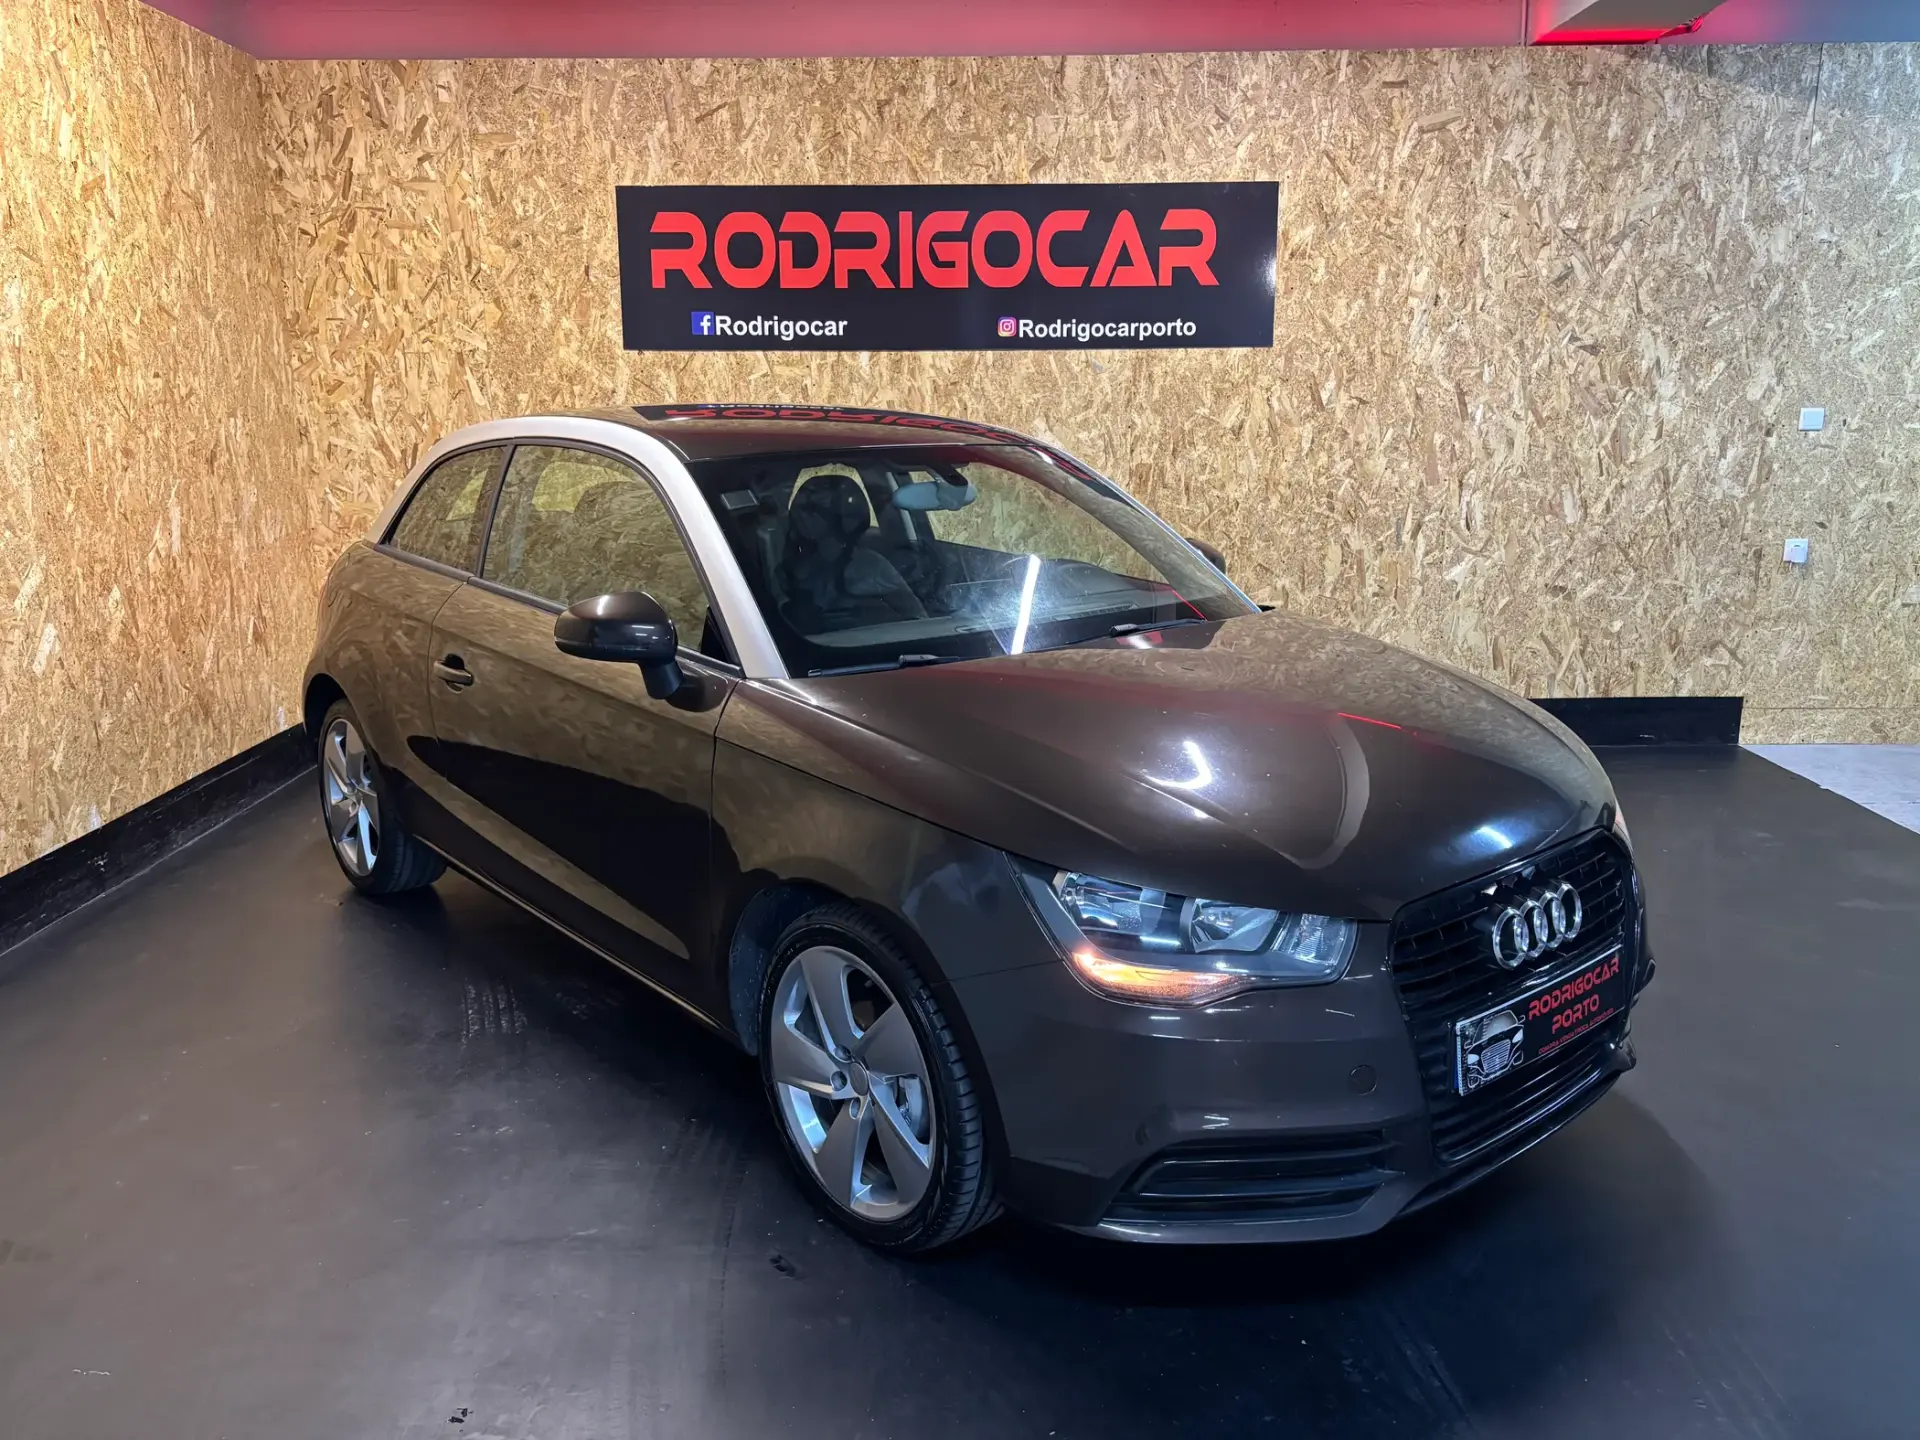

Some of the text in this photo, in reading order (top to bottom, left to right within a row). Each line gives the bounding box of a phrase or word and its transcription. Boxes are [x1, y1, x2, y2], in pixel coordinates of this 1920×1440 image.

[649, 208, 1219, 289] RODRIGOCAR
[715, 315, 848, 341] Rodrigocar
[1018, 317, 1197, 341] Rodrigocarporto
[1528, 956, 1620, 1021] RODRIGOCAR
[1552, 994, 1600, 1034] PORTO
